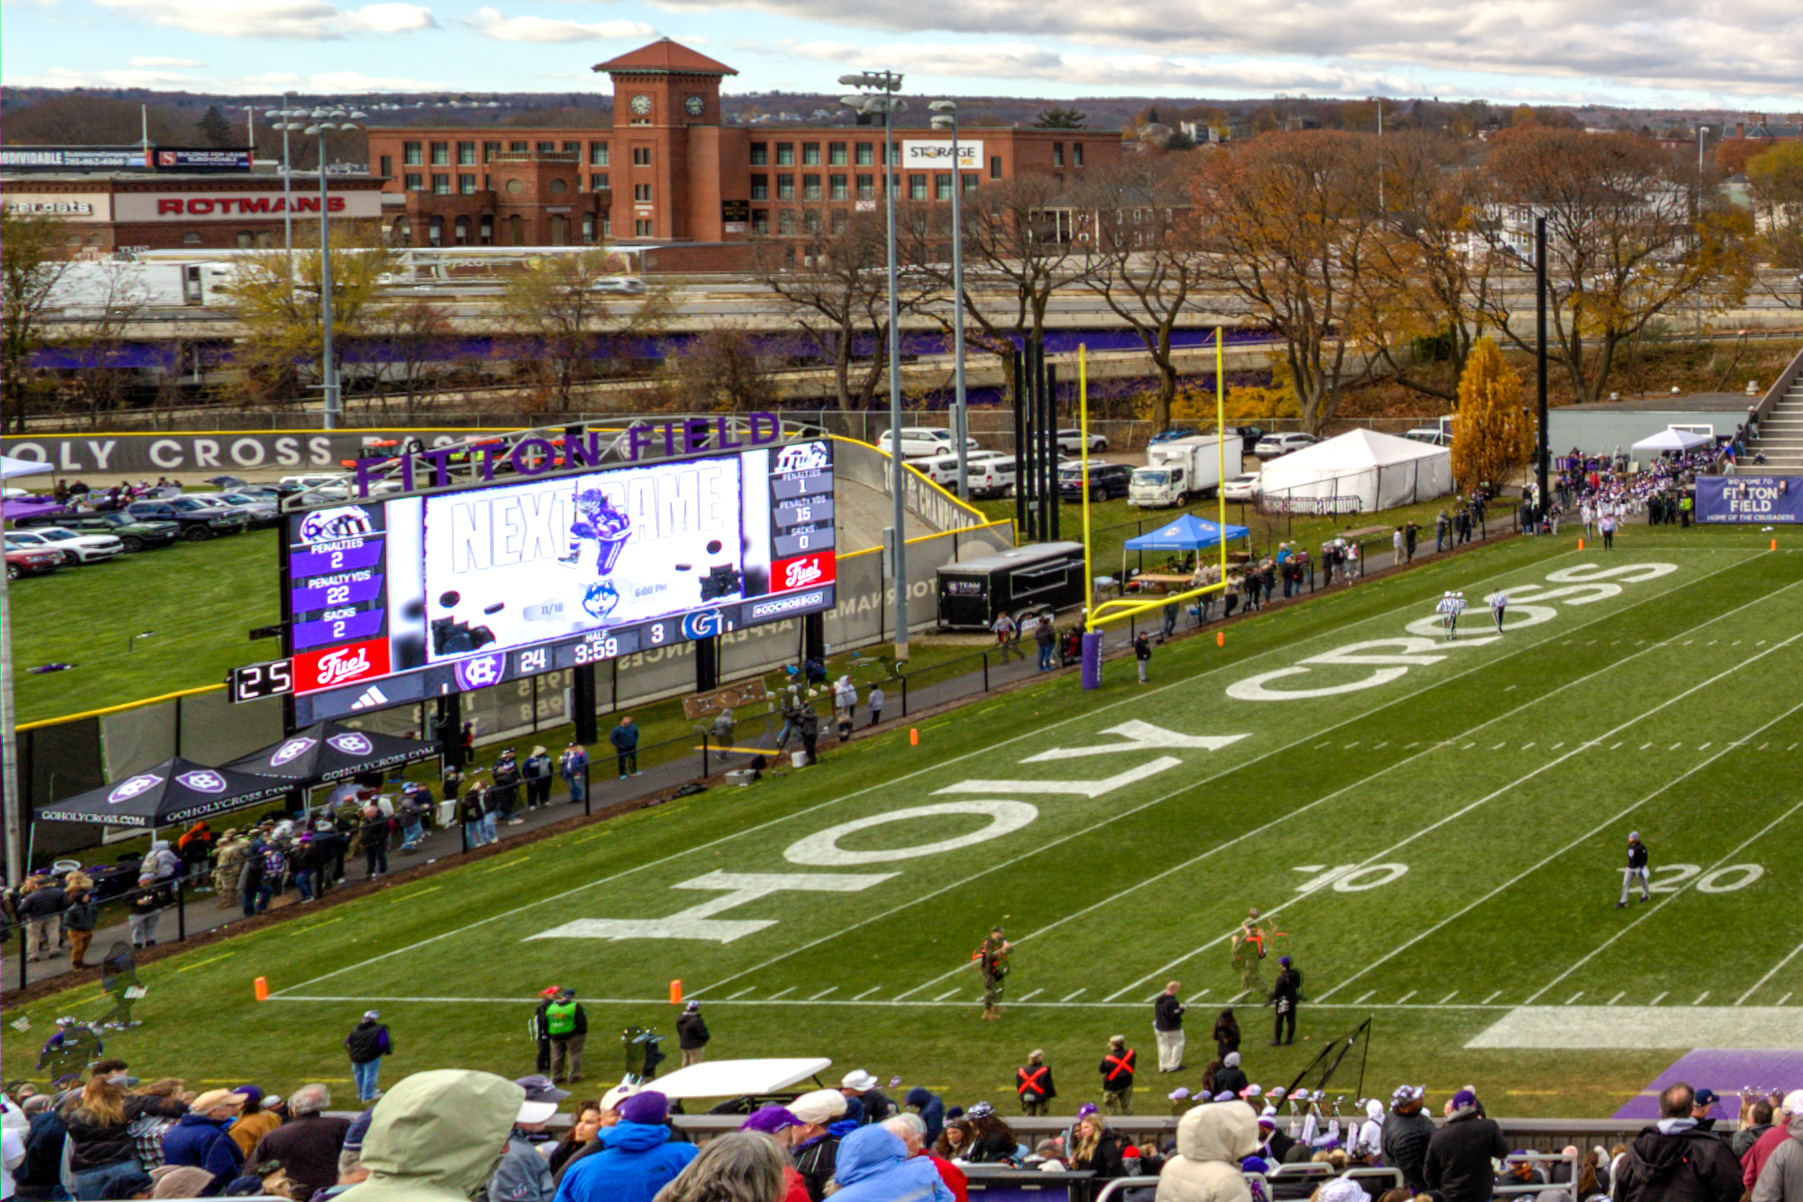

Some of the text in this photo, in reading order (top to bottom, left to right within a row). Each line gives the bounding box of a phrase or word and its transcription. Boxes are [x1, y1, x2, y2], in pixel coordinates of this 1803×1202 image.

[158, 197, 346, 215] ROTMANS
[149, 437, 332, 469] CROSS
[357, 412, 780, 498] FITTON FIELD
[799, 479, 807, 493] 1
[1723, 487, 1778, 500] FITTON
[796, 507, 811, 522] 15
[1730, 500, 1771, 513] FIELD
[450, 486, 576, 575] NEXT
[311, 537, 364, 555] PENALTIES
[799, 535, 809, 549] 0
[331, 551, 344, 568] 2
[308, 569, 371, 589] PENALTY YDS
[785, 558, 821, 587] Fuel
[326, 585, 350, 605] 22
[323, 606, 356, 622] SACKS
[333, 621, 345, 638] 2
[585, 628, 608, 642] HALF
[520, 623, 664, 672] 24 3:59 3
[317, 647, 371, 684] Fuel
[239, 661, 291, 699] 25
[522, 561, 1679, 944] HOLY CROSS
[322, 744, 435, 782] GOHOLYCROSS.COM
[166, 783, 295, 823] GOHOLYCROSS.COM
[41, 809, 146, 827] GOHOLYCROSS.COM
[1293, 862, 1409, 893] 10
